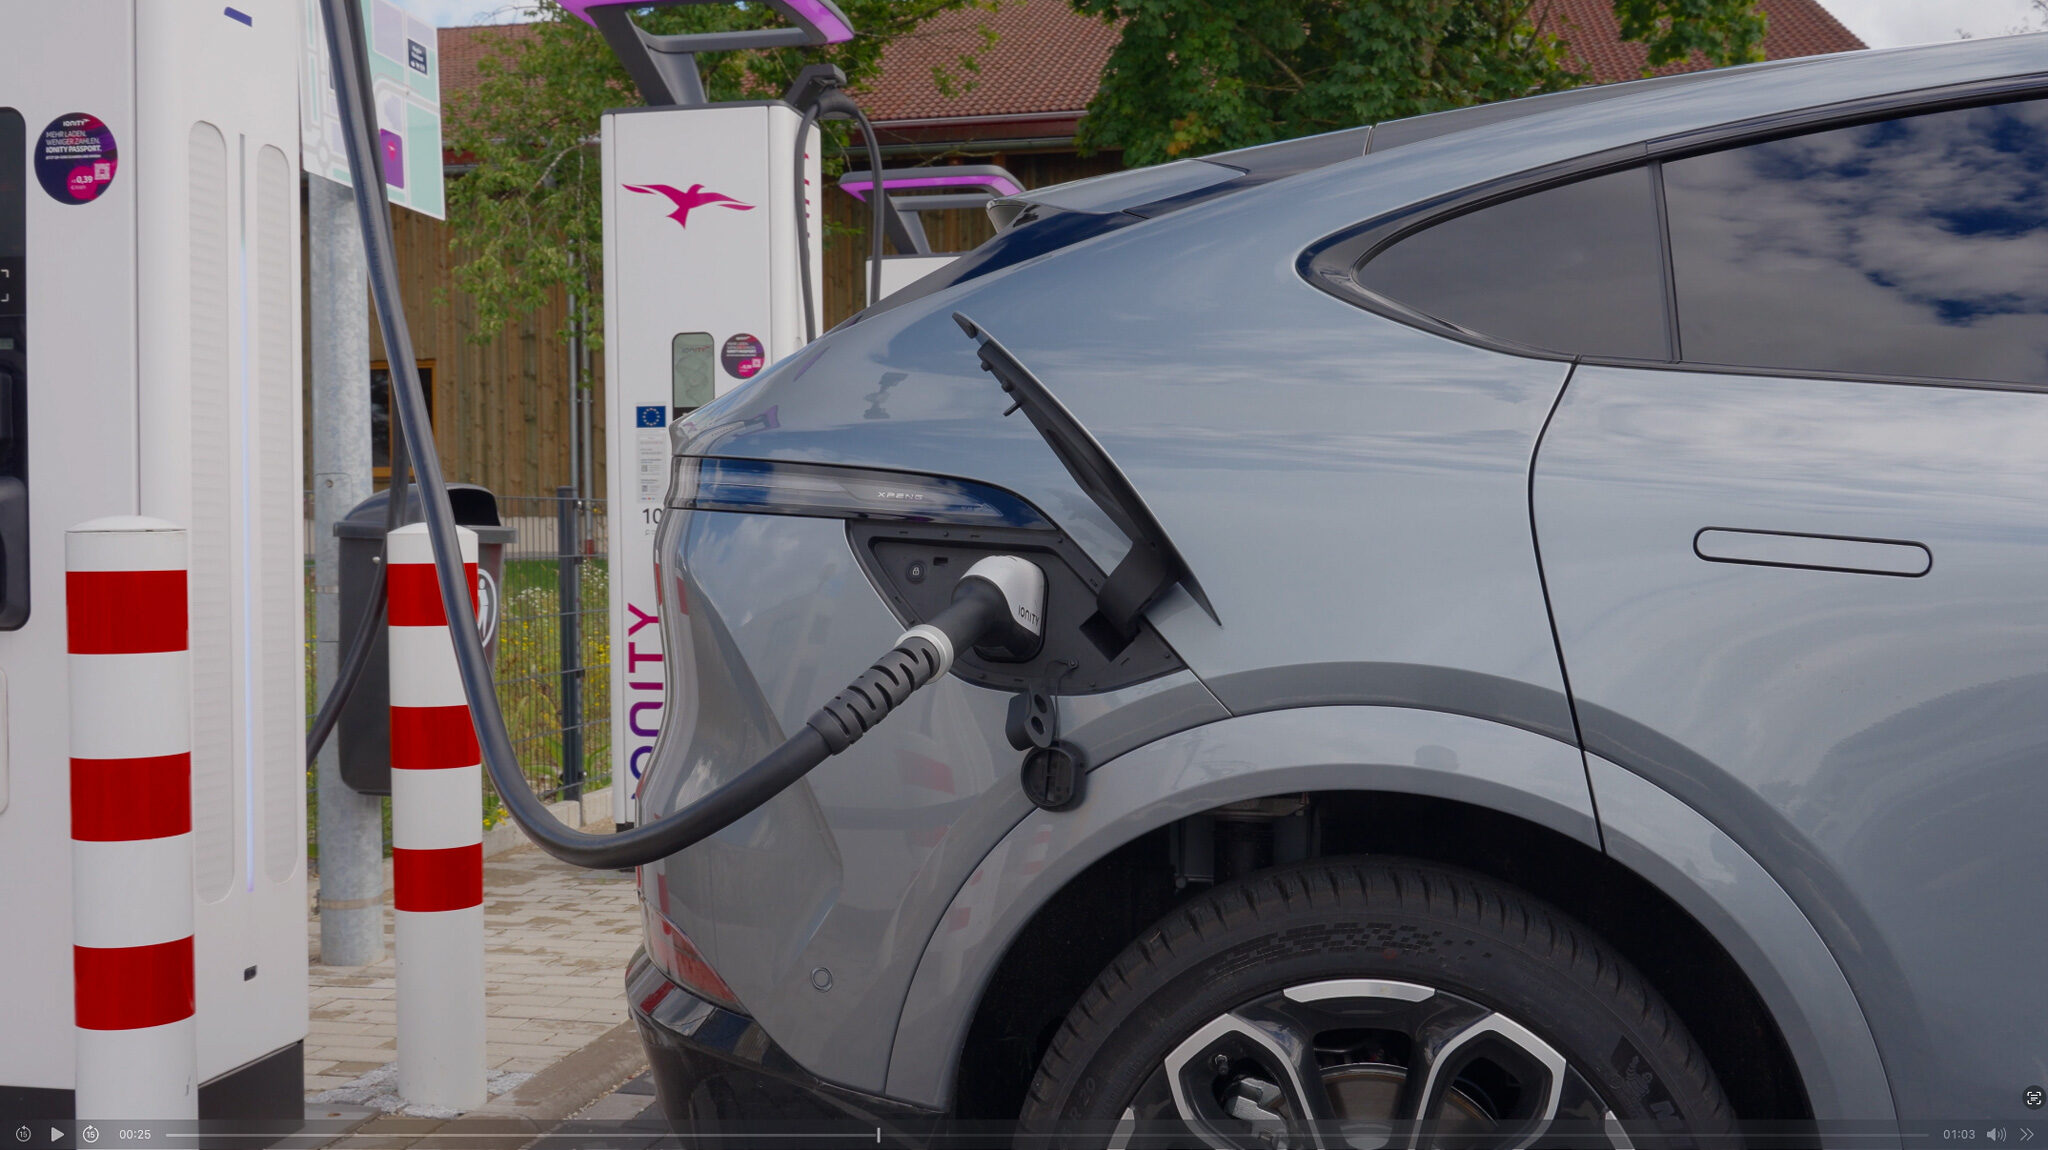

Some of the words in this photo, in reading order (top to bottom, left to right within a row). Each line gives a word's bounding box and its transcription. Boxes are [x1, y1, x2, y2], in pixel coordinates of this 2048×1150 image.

[62, 119, 85, 127] IONITY
[46, 138, 75, 146] WENIGER
[45, 146, 68, 154] IONITY
[76, 175, 93, 184] 0,39
[878, 491, 923, 500] XPENG
[1018, 604, 1040, 627] IONITY
[628, 603, 664, 800] ONITY
